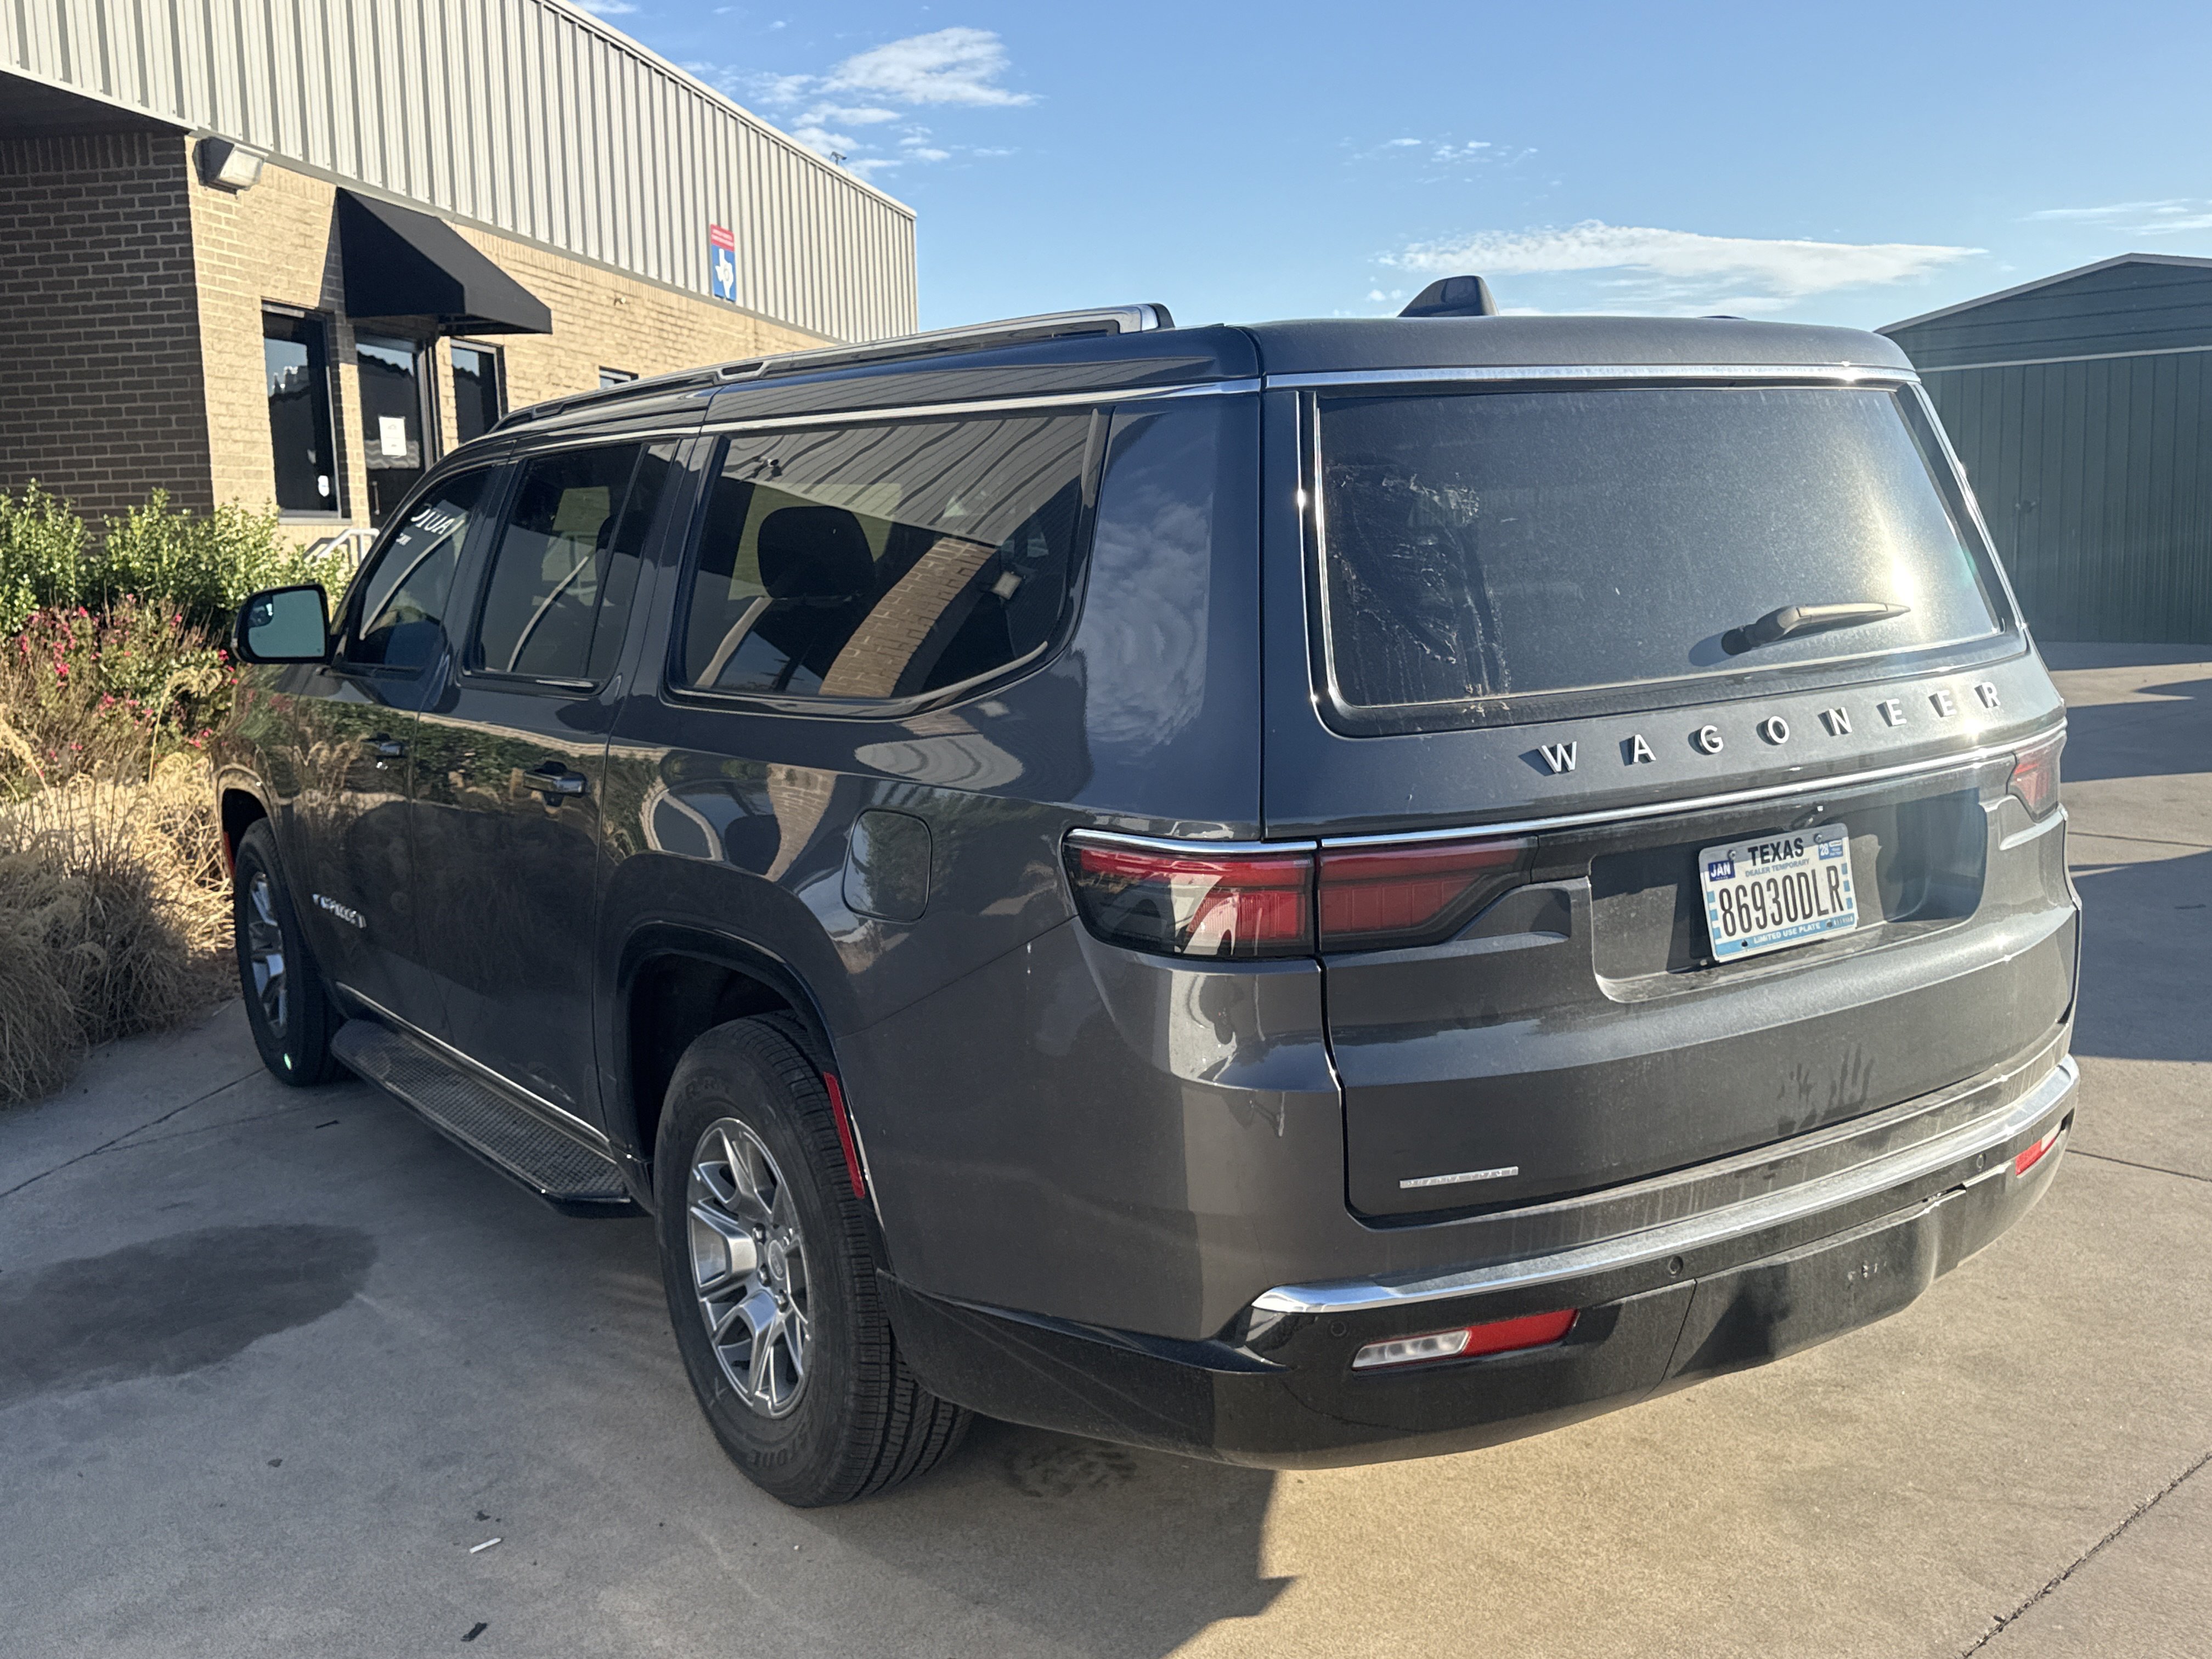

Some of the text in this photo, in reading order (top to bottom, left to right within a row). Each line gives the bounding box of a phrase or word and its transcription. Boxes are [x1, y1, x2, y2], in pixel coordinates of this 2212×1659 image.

[1541, 681, 2001, 773] WAGONEER
[1748, 837, 1804, 866] TEXAS
[1819, 843, 1829, 856] 28
[1710, 862, 1731, 878] JAN
[1745, 858, 1810, 877] DEALER TEMPORARY
[1718, 865, 1844, 937] 86930DLR
[1753, 923, 1821, 944] LIMITED USE PLATE
